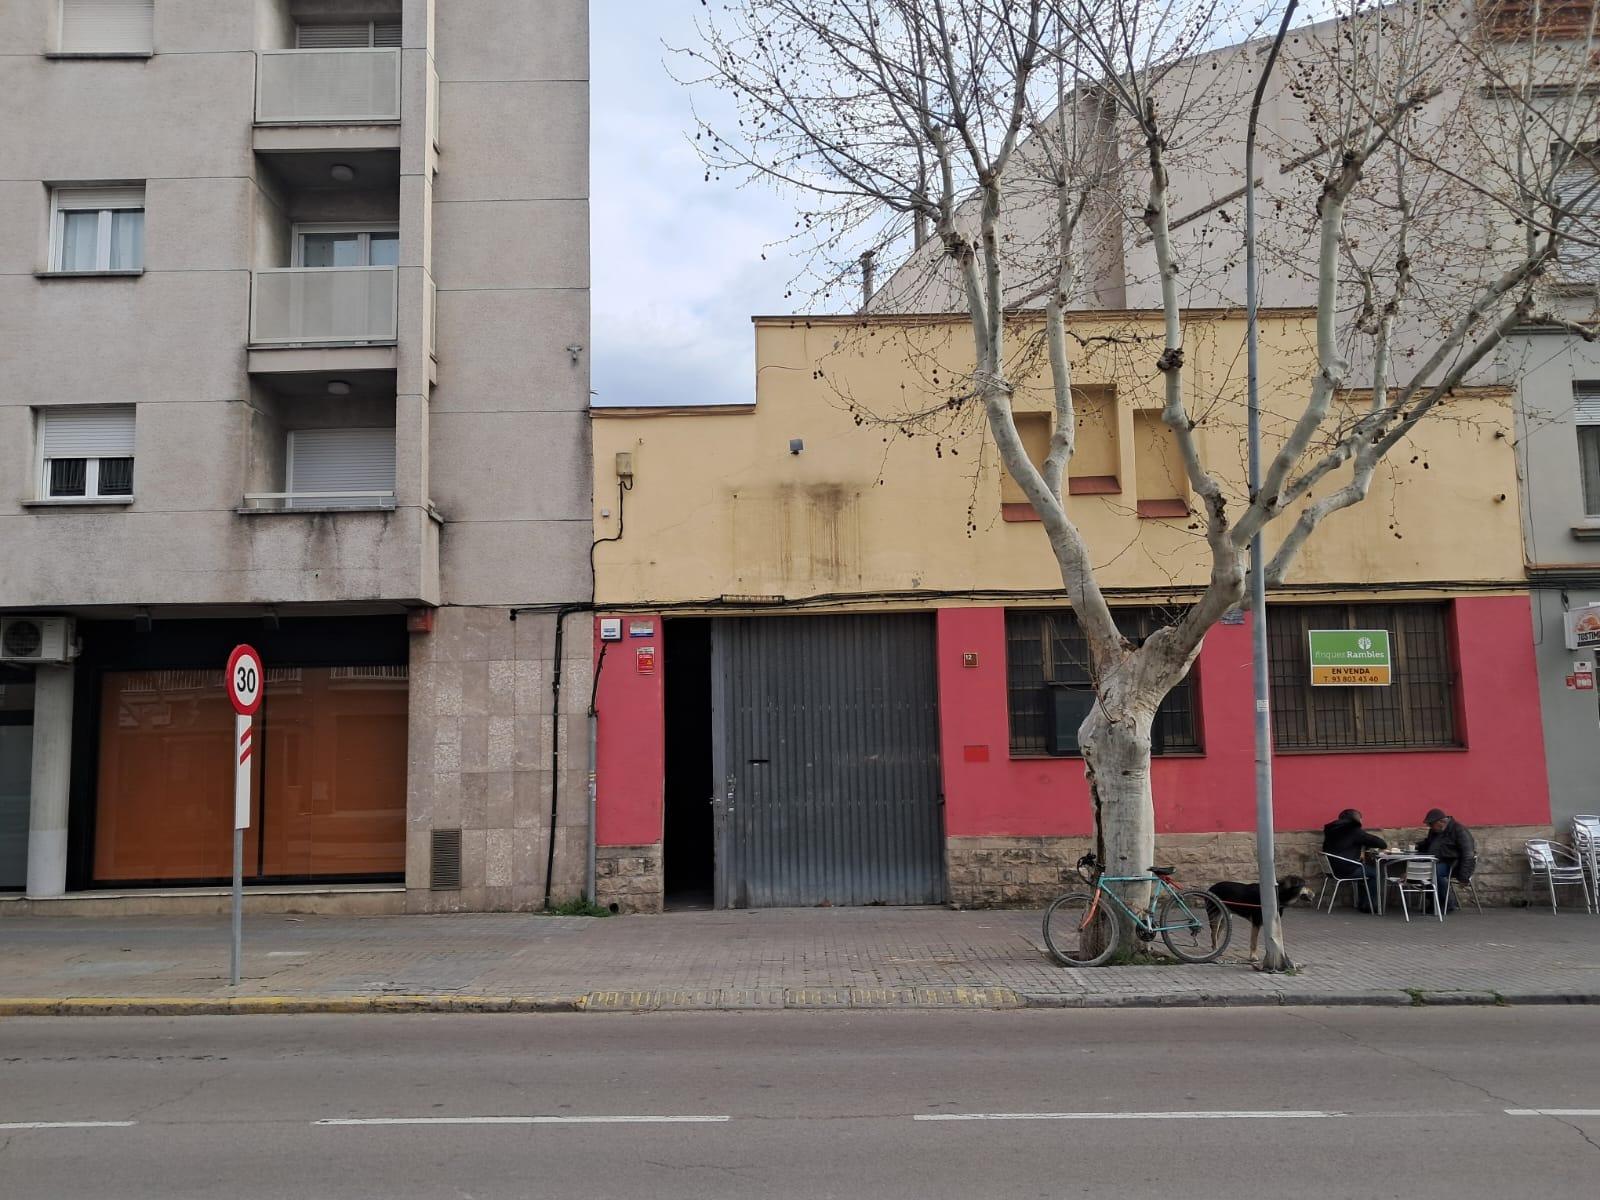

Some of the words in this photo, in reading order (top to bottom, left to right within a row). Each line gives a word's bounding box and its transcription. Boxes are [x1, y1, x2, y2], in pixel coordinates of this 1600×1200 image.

[1346, 650, 1385, 659] Rambles
[237, 666, 256, 693] 30
[1368, 675, 1379, 683] 40
